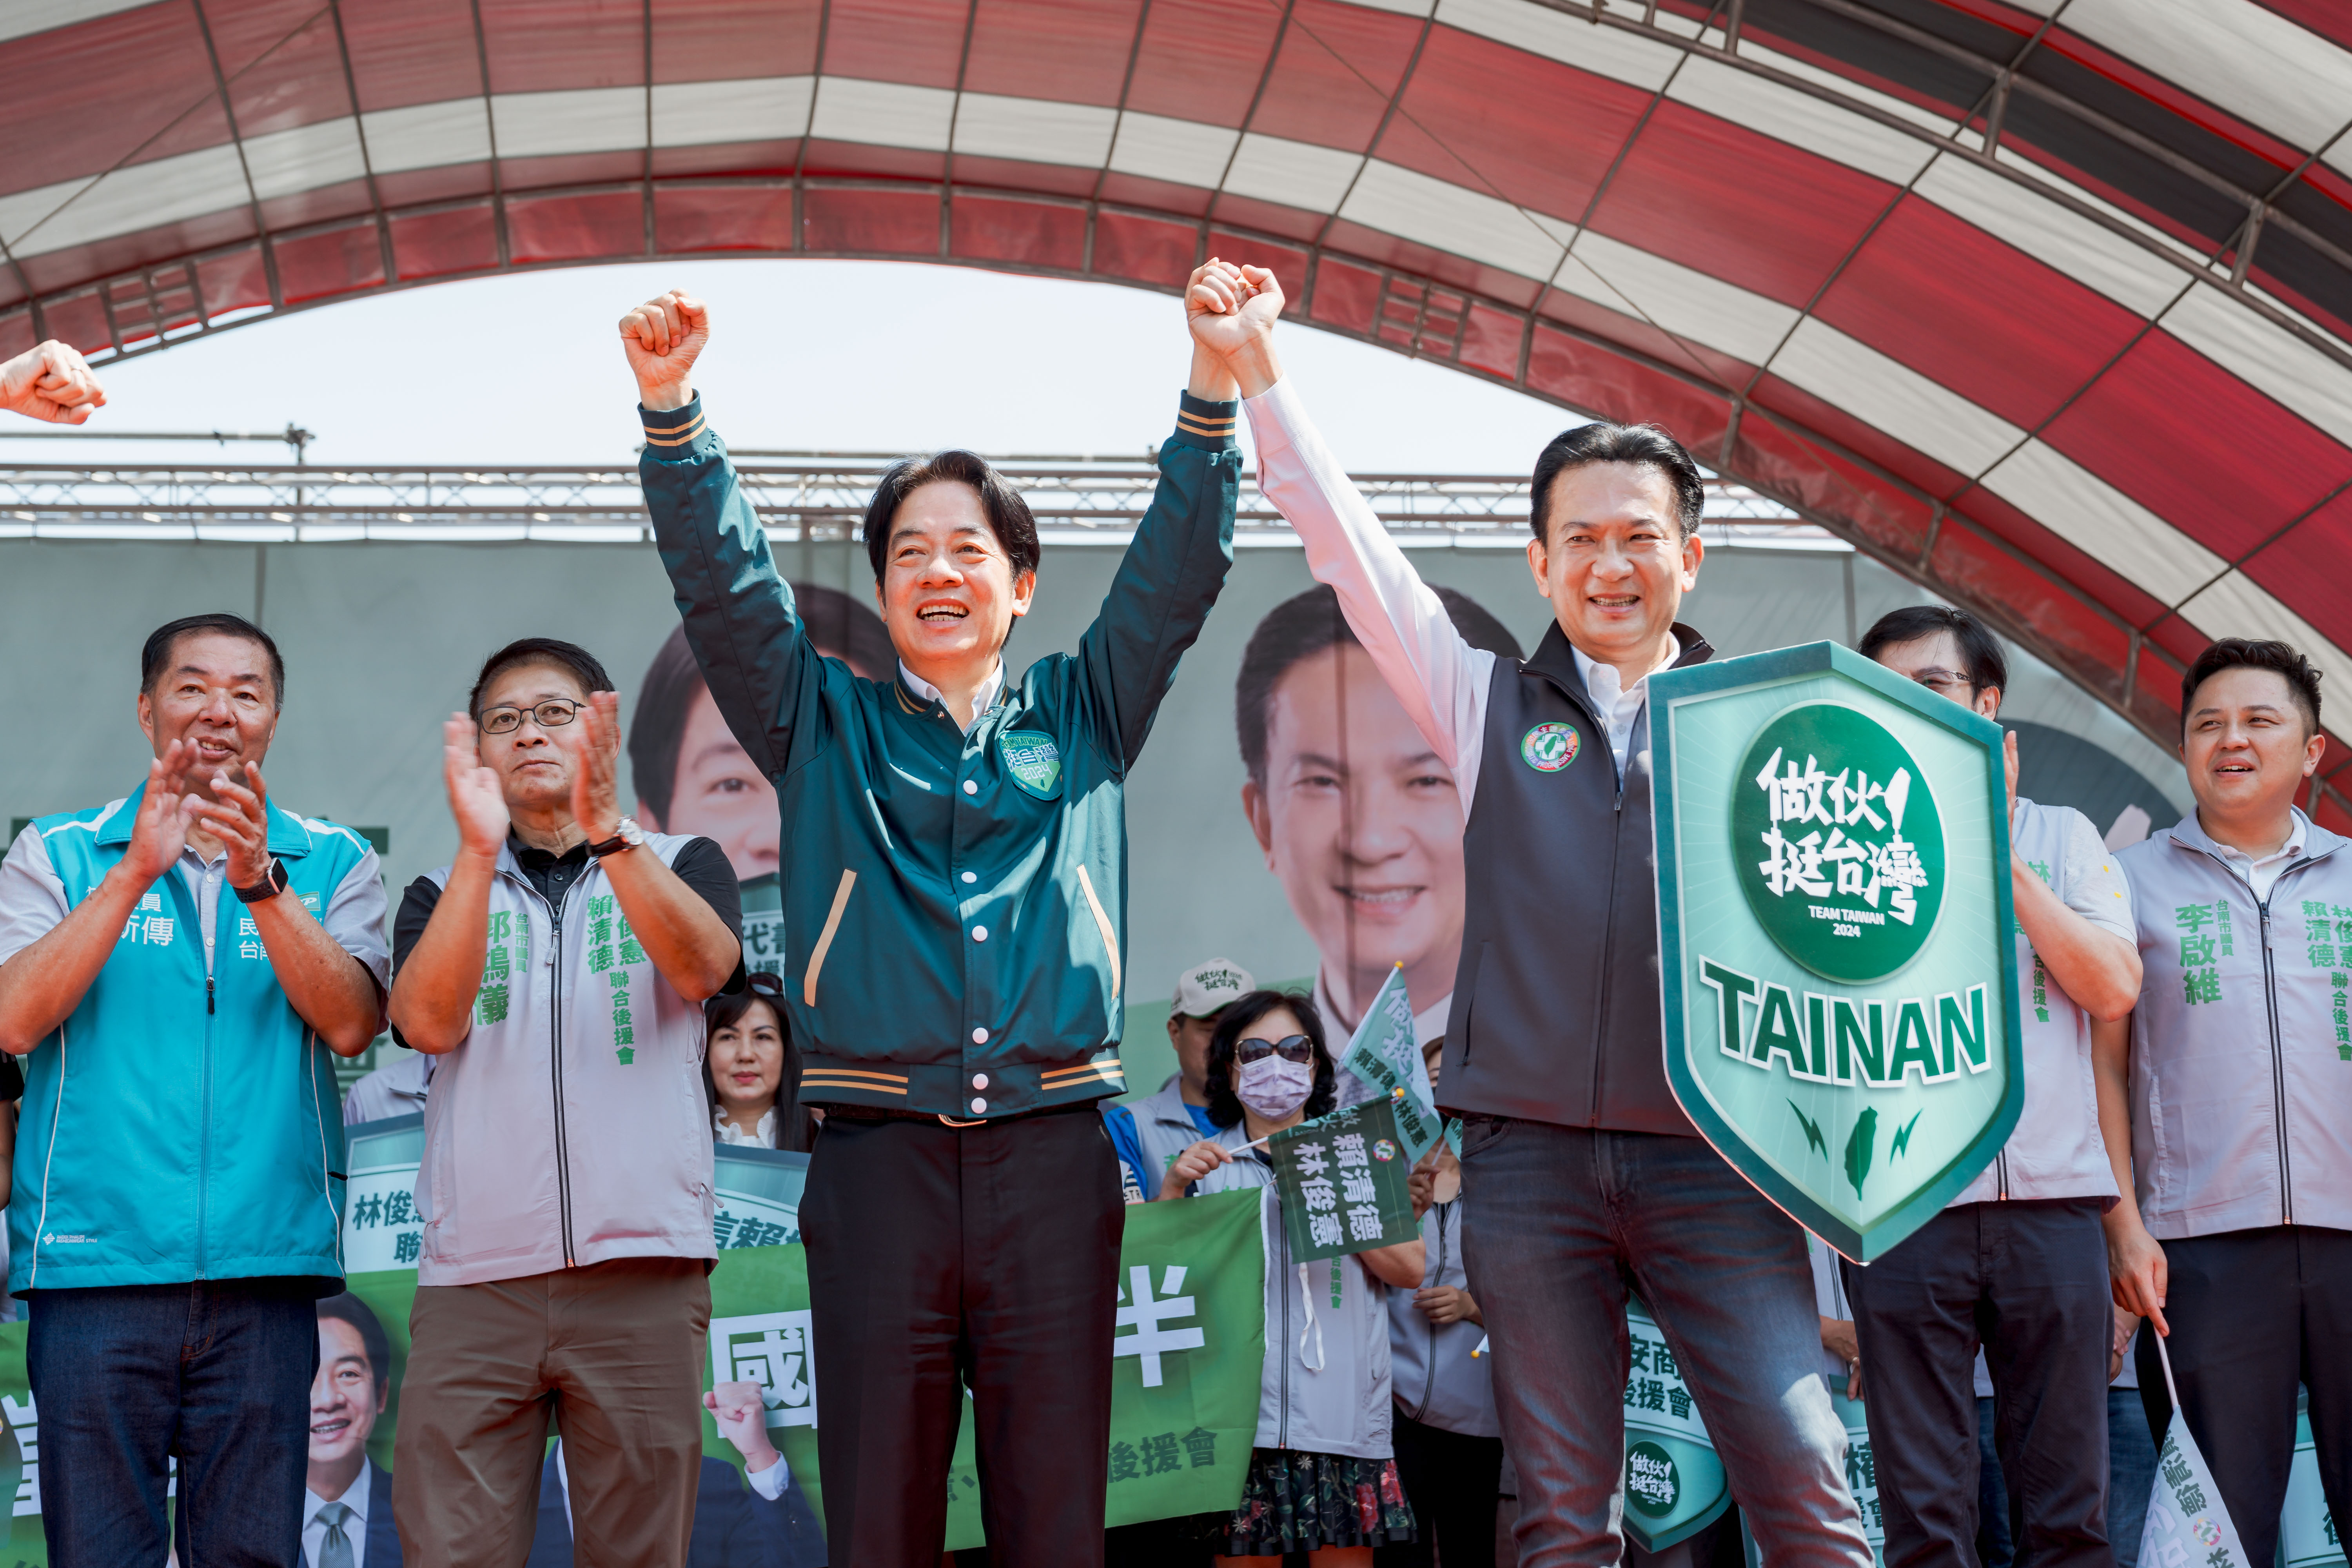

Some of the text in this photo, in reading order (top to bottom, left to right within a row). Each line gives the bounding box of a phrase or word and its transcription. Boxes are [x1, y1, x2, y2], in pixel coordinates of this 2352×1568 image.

[1001, 736, 1048, 750] TEAM TAIWAN
[1021, 764, 1053, 780] 2024
[1758, 826, 1929, 926] 挺台灣
[514, 913, 529, 973] 台南市議員
[587, 895, 614, 974] 賴清德
[1808, 905, 1885, 926] TEAM TAIWAN
[1832, 923, 1861, 938] 2024
[2216, 899, 2234, 956] 台南市議員
[2301, 900, 2336, 968] 賴清德
[609, 970, 635, 1065] 聯合後援會
[1699, 954, 1992, 1088] TAINAN
[2331, 971, 2352, 1062] 聯合後援會
[352, 1190, 426, 1230] 林俊
[1293, 1142, 1344, 1248] 林俊憲
[1332, 1133, 1383, 1241] 賴清德
[1629, 1471, 1675, 1504] 挺台灣
